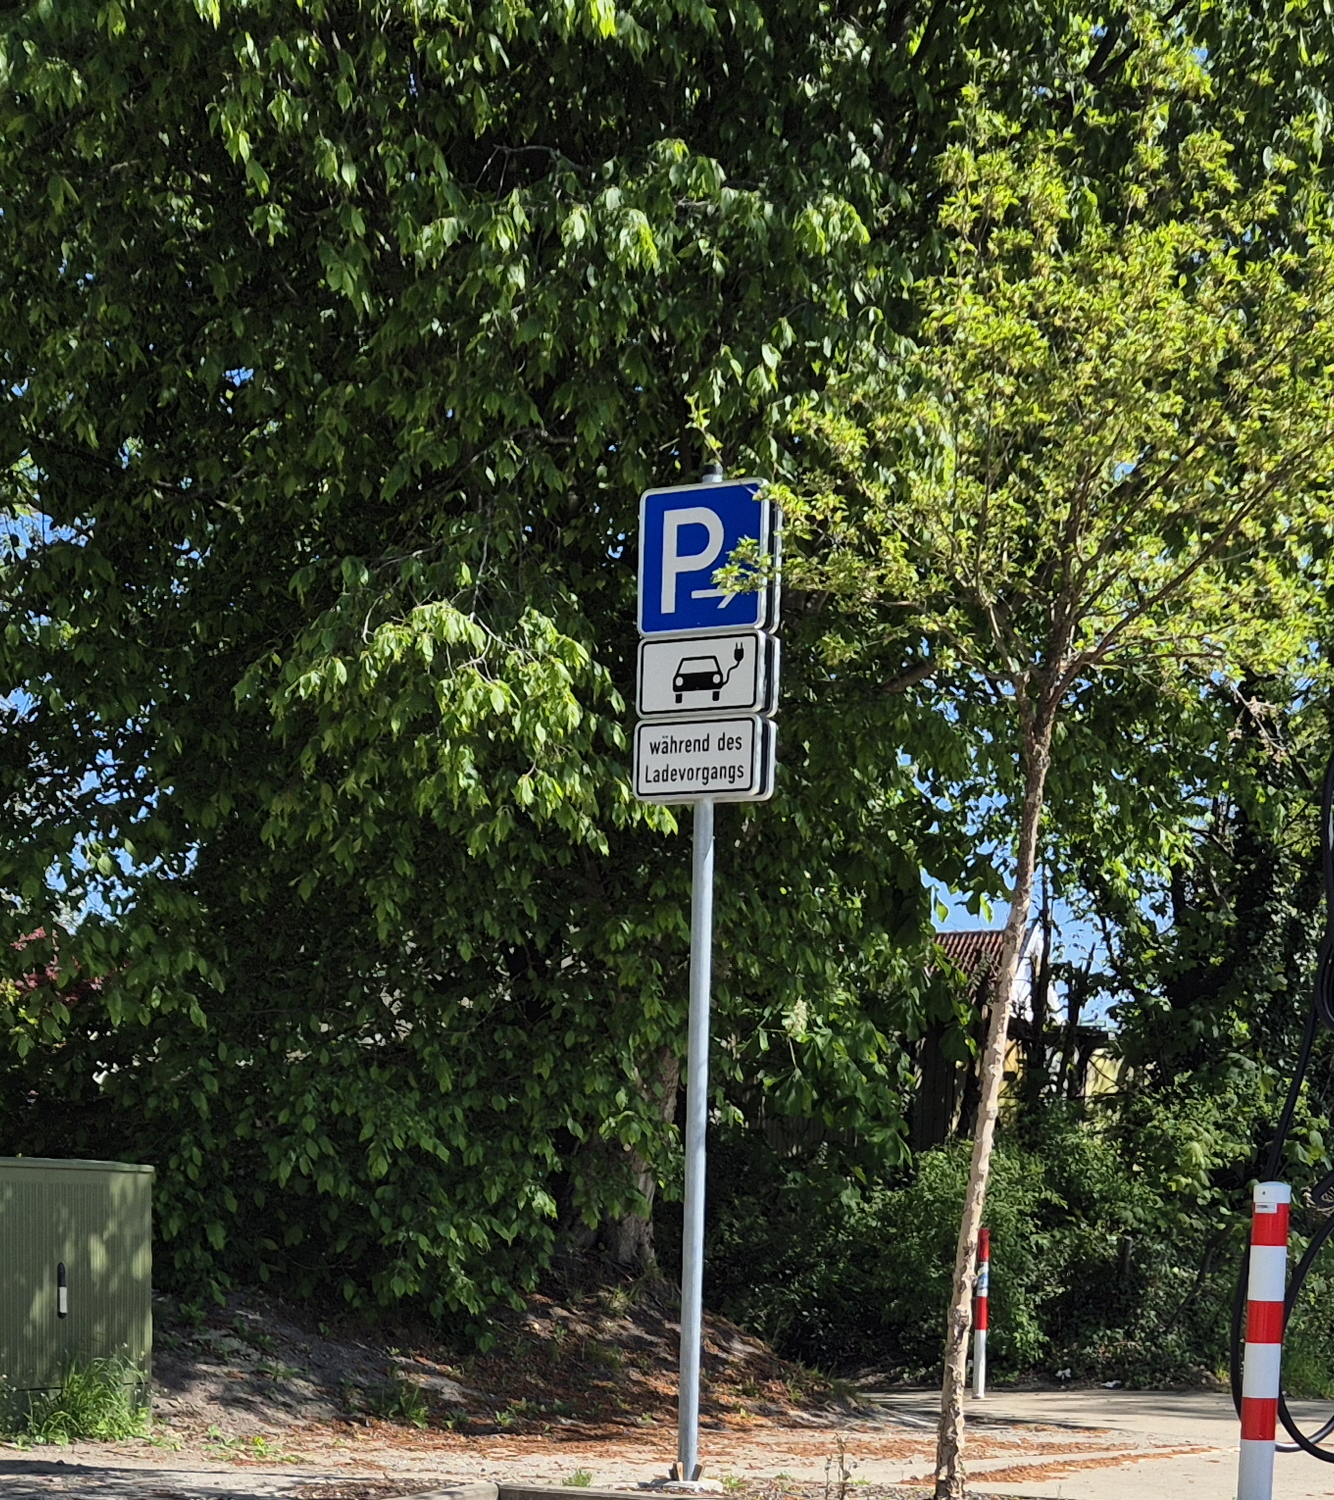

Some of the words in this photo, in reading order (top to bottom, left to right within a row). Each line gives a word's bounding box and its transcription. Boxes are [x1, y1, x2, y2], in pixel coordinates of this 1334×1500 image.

[661, 506, 724, 615] P
[649, 733, 710, 755] während
[717, 732, 743, 752] des
[645, 763, 745, 786] Ladevorgangs
